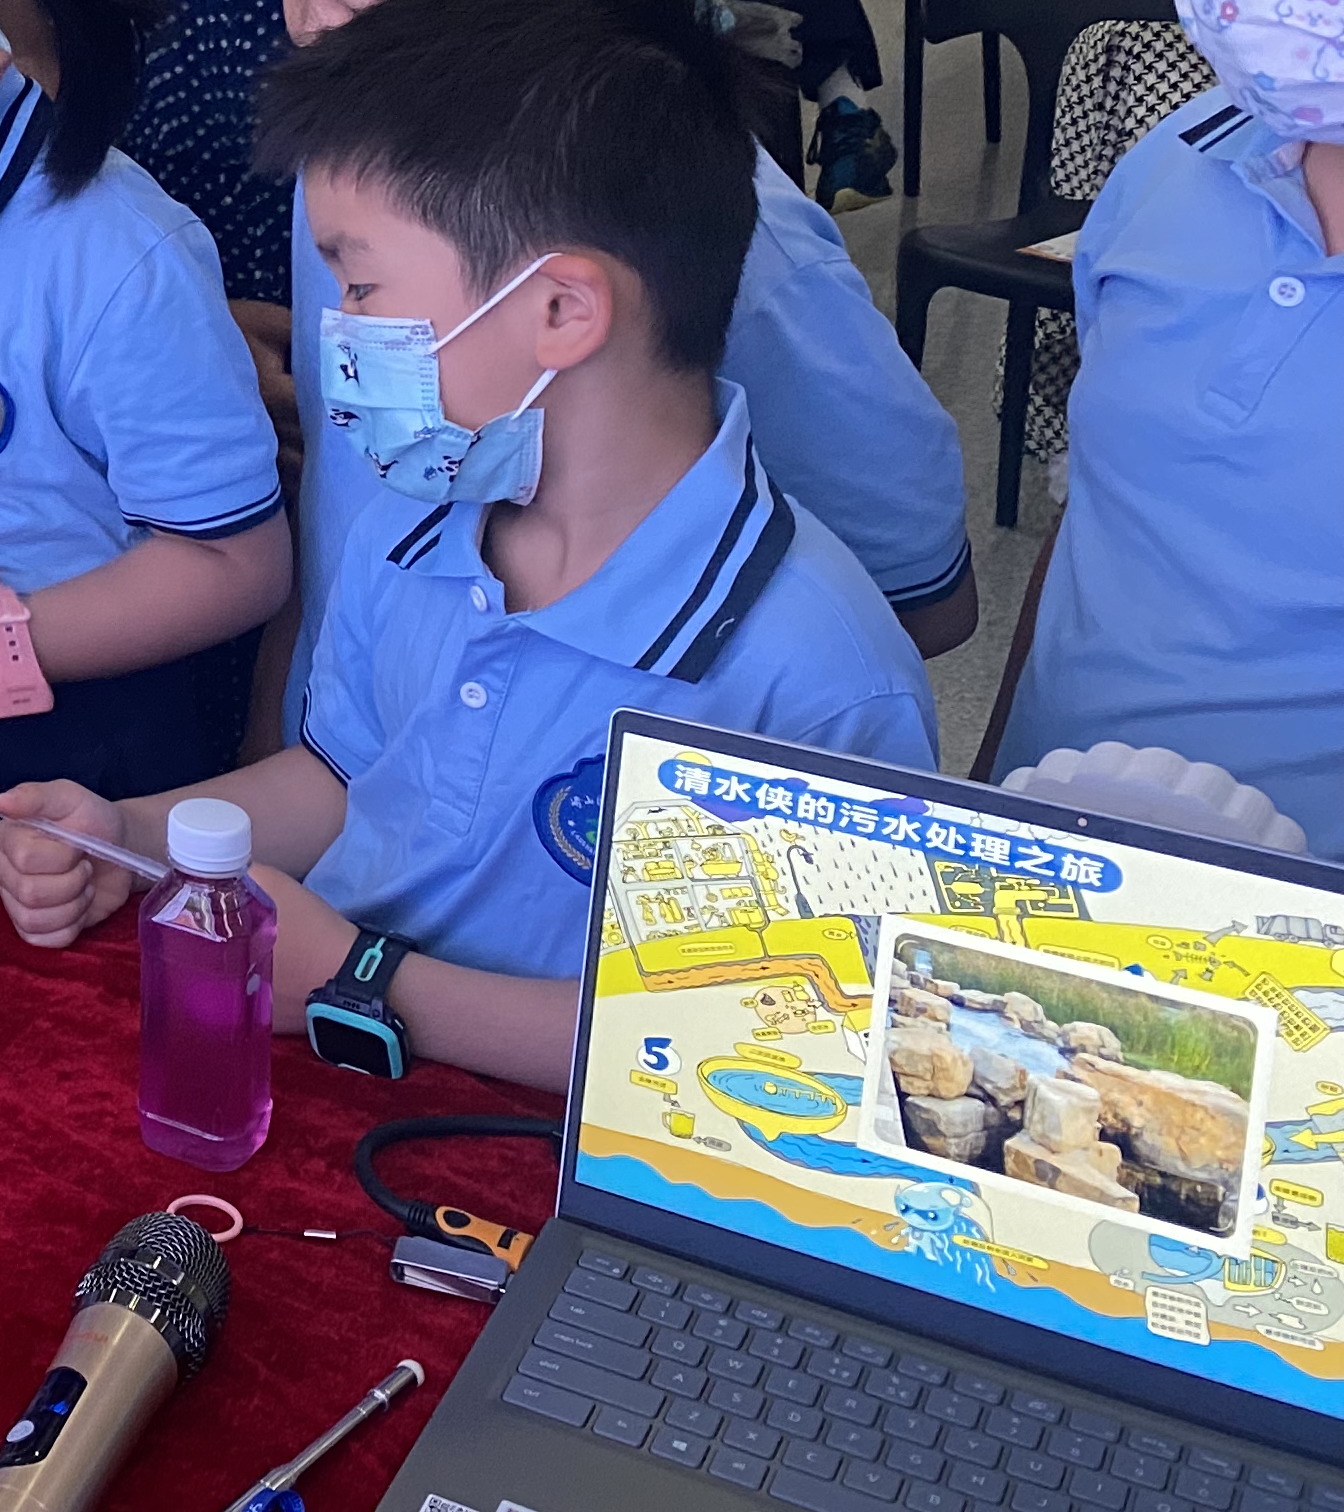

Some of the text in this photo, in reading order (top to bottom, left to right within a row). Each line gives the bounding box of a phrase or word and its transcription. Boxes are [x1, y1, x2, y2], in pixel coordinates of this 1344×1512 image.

[674, 763, 1107, 888] 清水侠的污水处理之旅
[643, 1037, 672, 1071] 5
